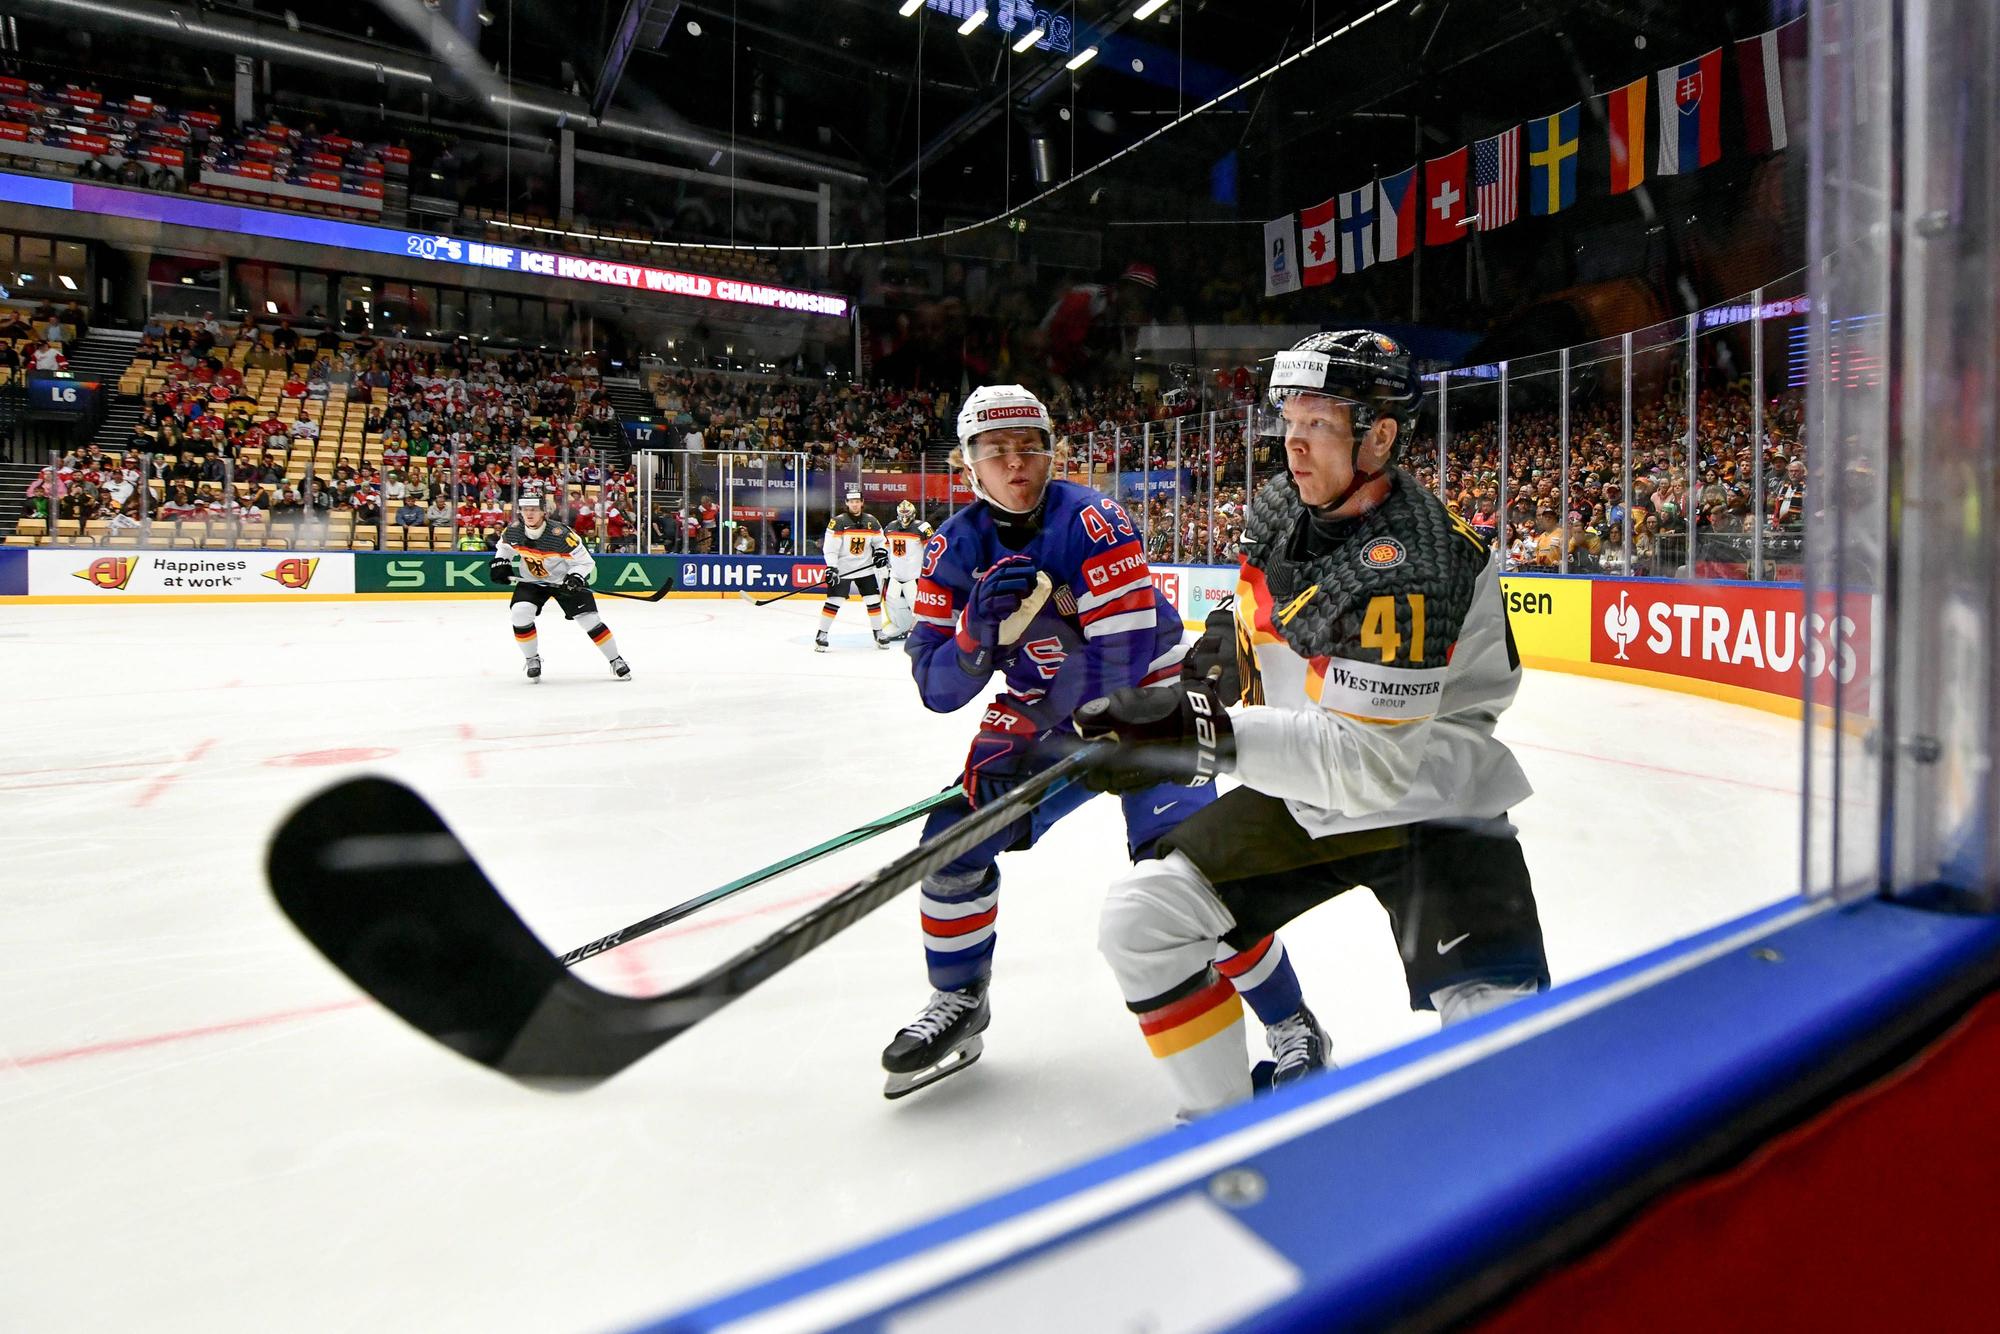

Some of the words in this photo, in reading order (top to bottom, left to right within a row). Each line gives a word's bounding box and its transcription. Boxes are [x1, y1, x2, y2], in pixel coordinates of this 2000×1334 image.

[520, 251, 554, 274] ICE
[558, 256, 641, 287] HOCKEY
[645, 269, 712, 297] WORLD
[717, 281, 847, 316] CHAMPIONSHIP
[52, 387, 77, 403] L6
[990, 408, 1040, 418] CHIPOTLE
[636, 428, 652, 441] L7
[864, 483, 880, 491] THE
[882, 484, 907, 492] PULSE
[1080, 499, 1134, 545] 43
[153, 558, 246, 573] Happiness
[164, 576, 183, 587] at
[797, 568, 825, 584] LIV
[1361, 594, 1425, 663] 41
[1647, 601, 1857, 684] STRAUSS
[1371, 697, 1406, 709] GROUP
